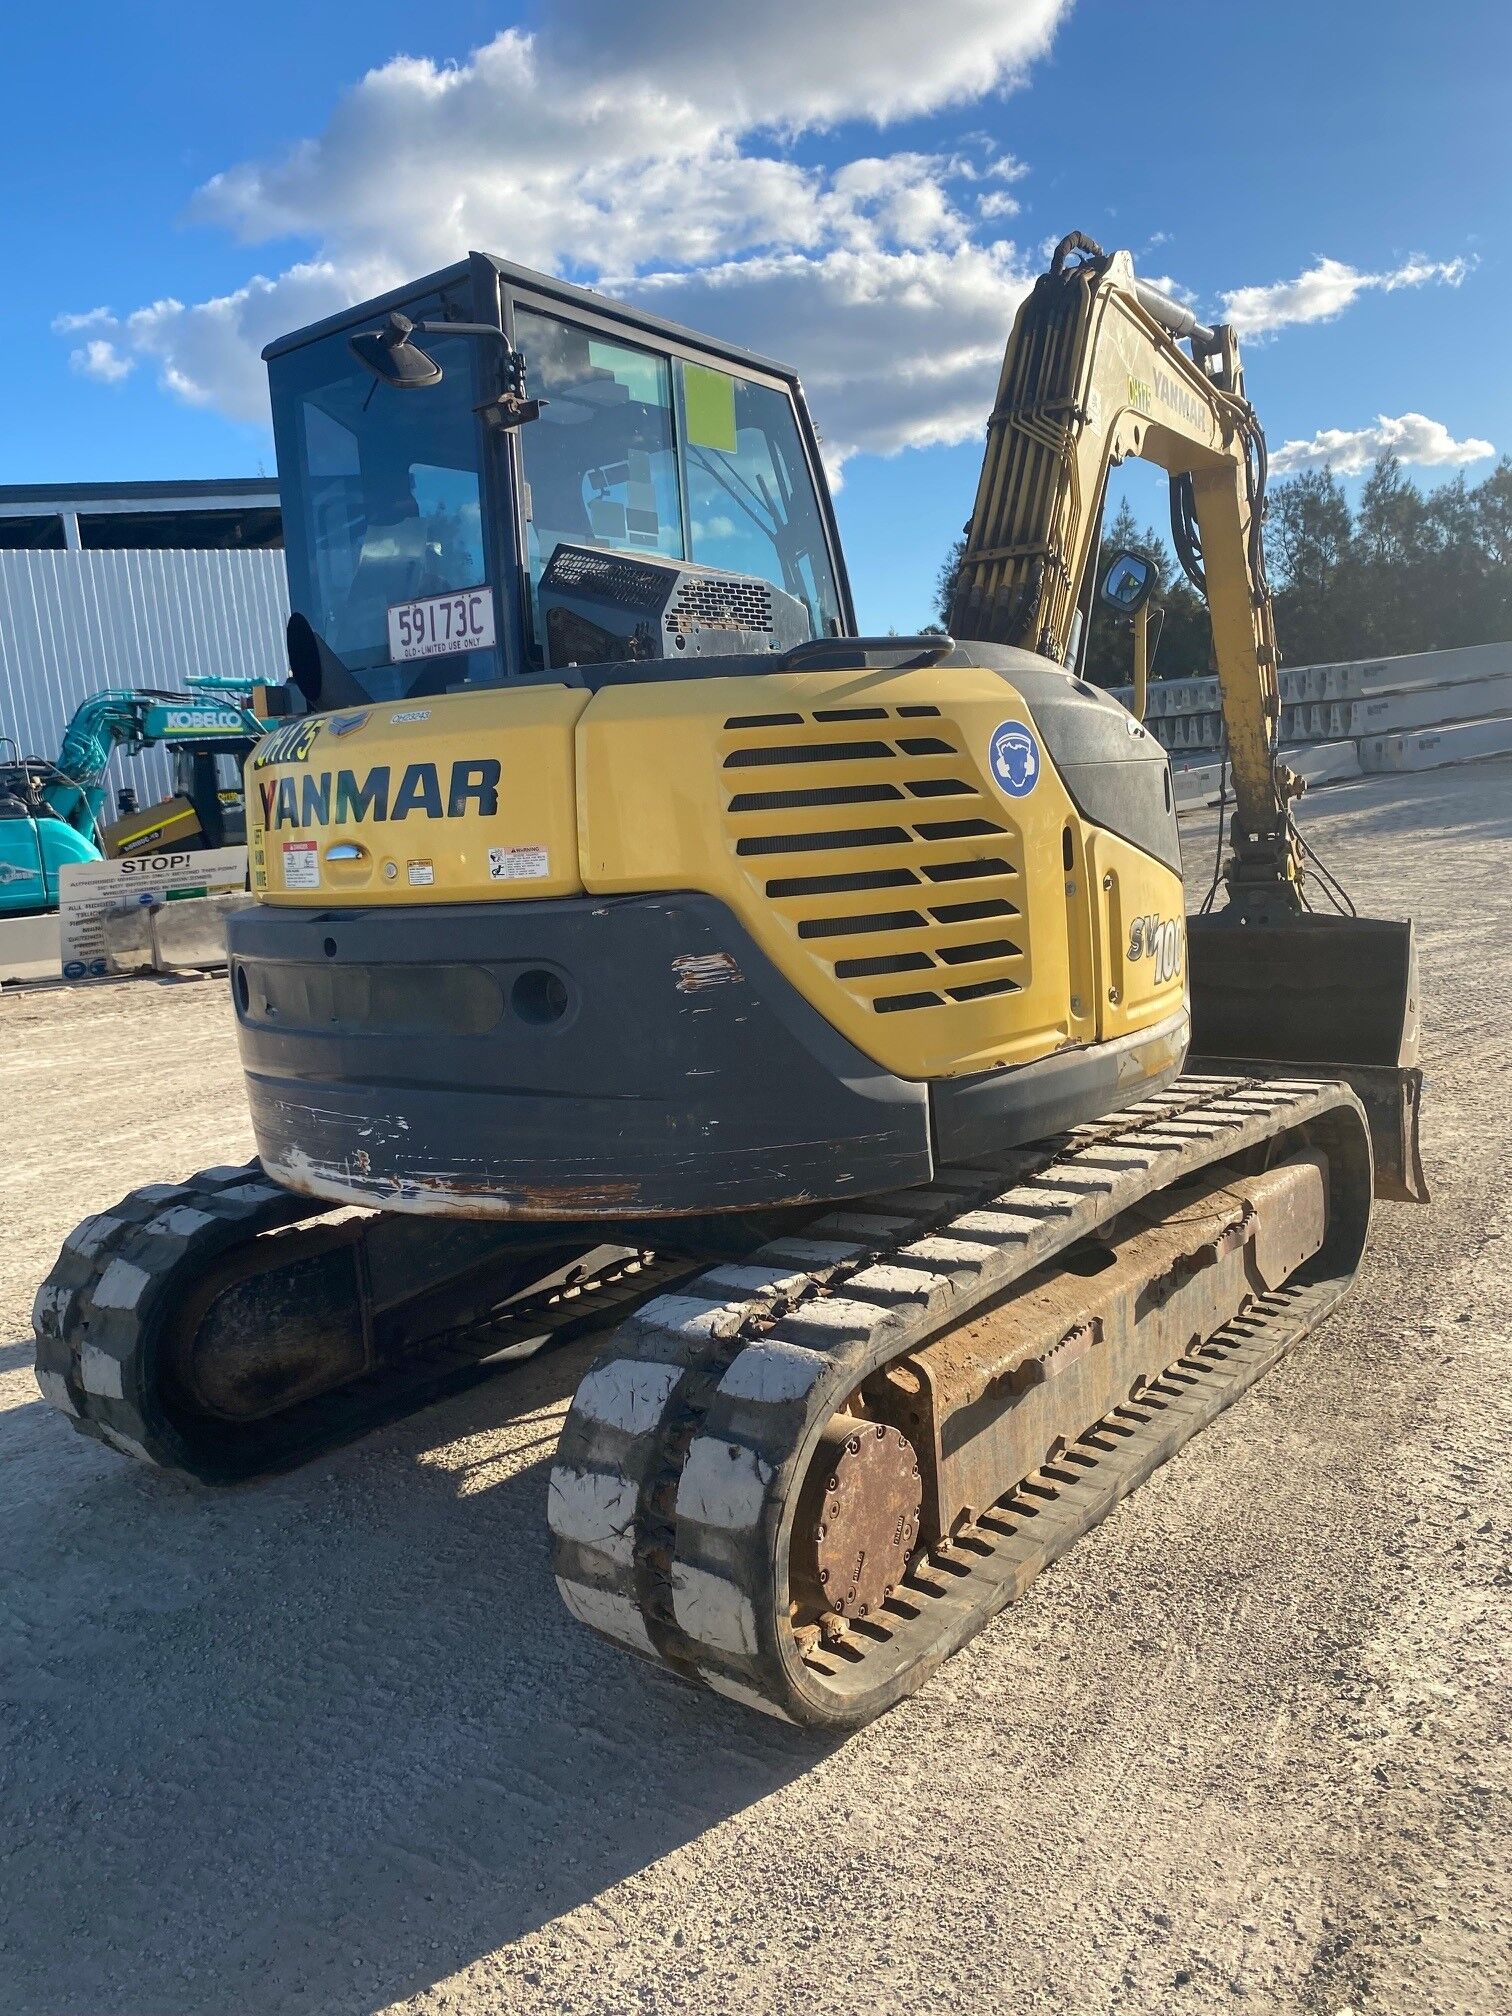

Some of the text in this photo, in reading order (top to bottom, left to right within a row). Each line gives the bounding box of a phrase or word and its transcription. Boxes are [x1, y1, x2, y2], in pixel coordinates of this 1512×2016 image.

[1153, 366, 1206, 433] YANMAR
[399, 597, 484, 646] 59173C
[449, 641, 461, 650] USE
[464, 637, 480, 648] ONLY
[167, 711, 242, 728] KOBELCO
[259, 759, 501, 831] YANMAR
[121, 854, 191, 875] STOP!
